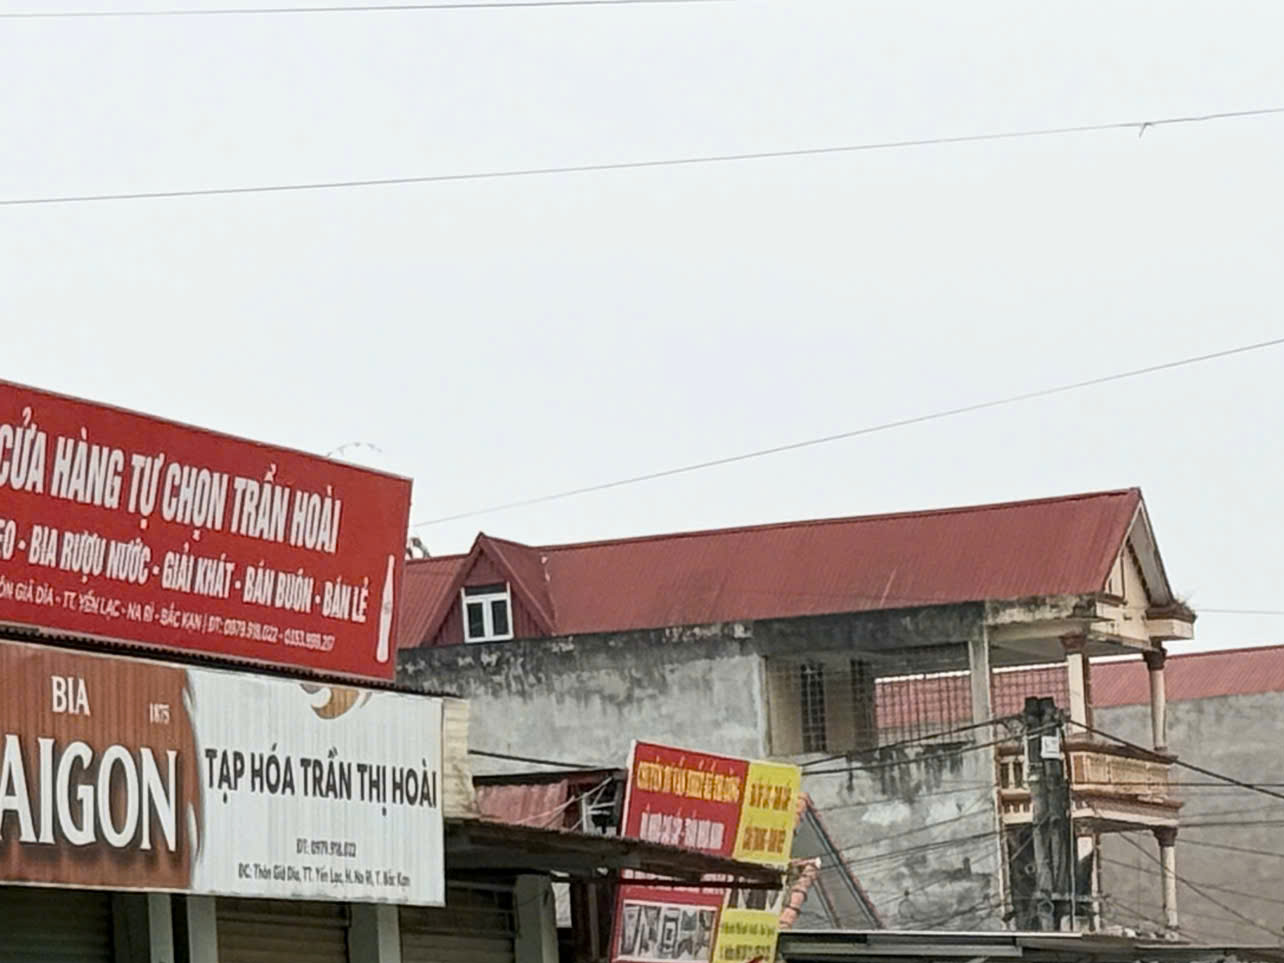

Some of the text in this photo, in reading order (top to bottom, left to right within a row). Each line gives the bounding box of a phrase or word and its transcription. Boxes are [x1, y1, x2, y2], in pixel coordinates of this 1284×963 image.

[0, 406, 47, 493] CỬA
[50, 426, 125, 509] HÀNG
[128, 452, 165, 529] TỰ
[162, 462, 229, 541] CHỌN
[290, 484, 341, 553] HOÀI
[29, 524, 58, 568] BIA
[60, 531, 107, 583] RƯỢU
[106, 537, 151, 585] NƯỚC
[162, 542, 194, 592] GIẢI
[194, 553, 235, 598] KHÁT
[243, 560, 275, 606] BÁN
[322, 575, 351, 620] BÁN
[126, 601, 141, 621] NA
[51, 676, 90, 716] BIA
[205, 743, 437, 816] TẠP HÓA TRẦN THỊ HOÀI
